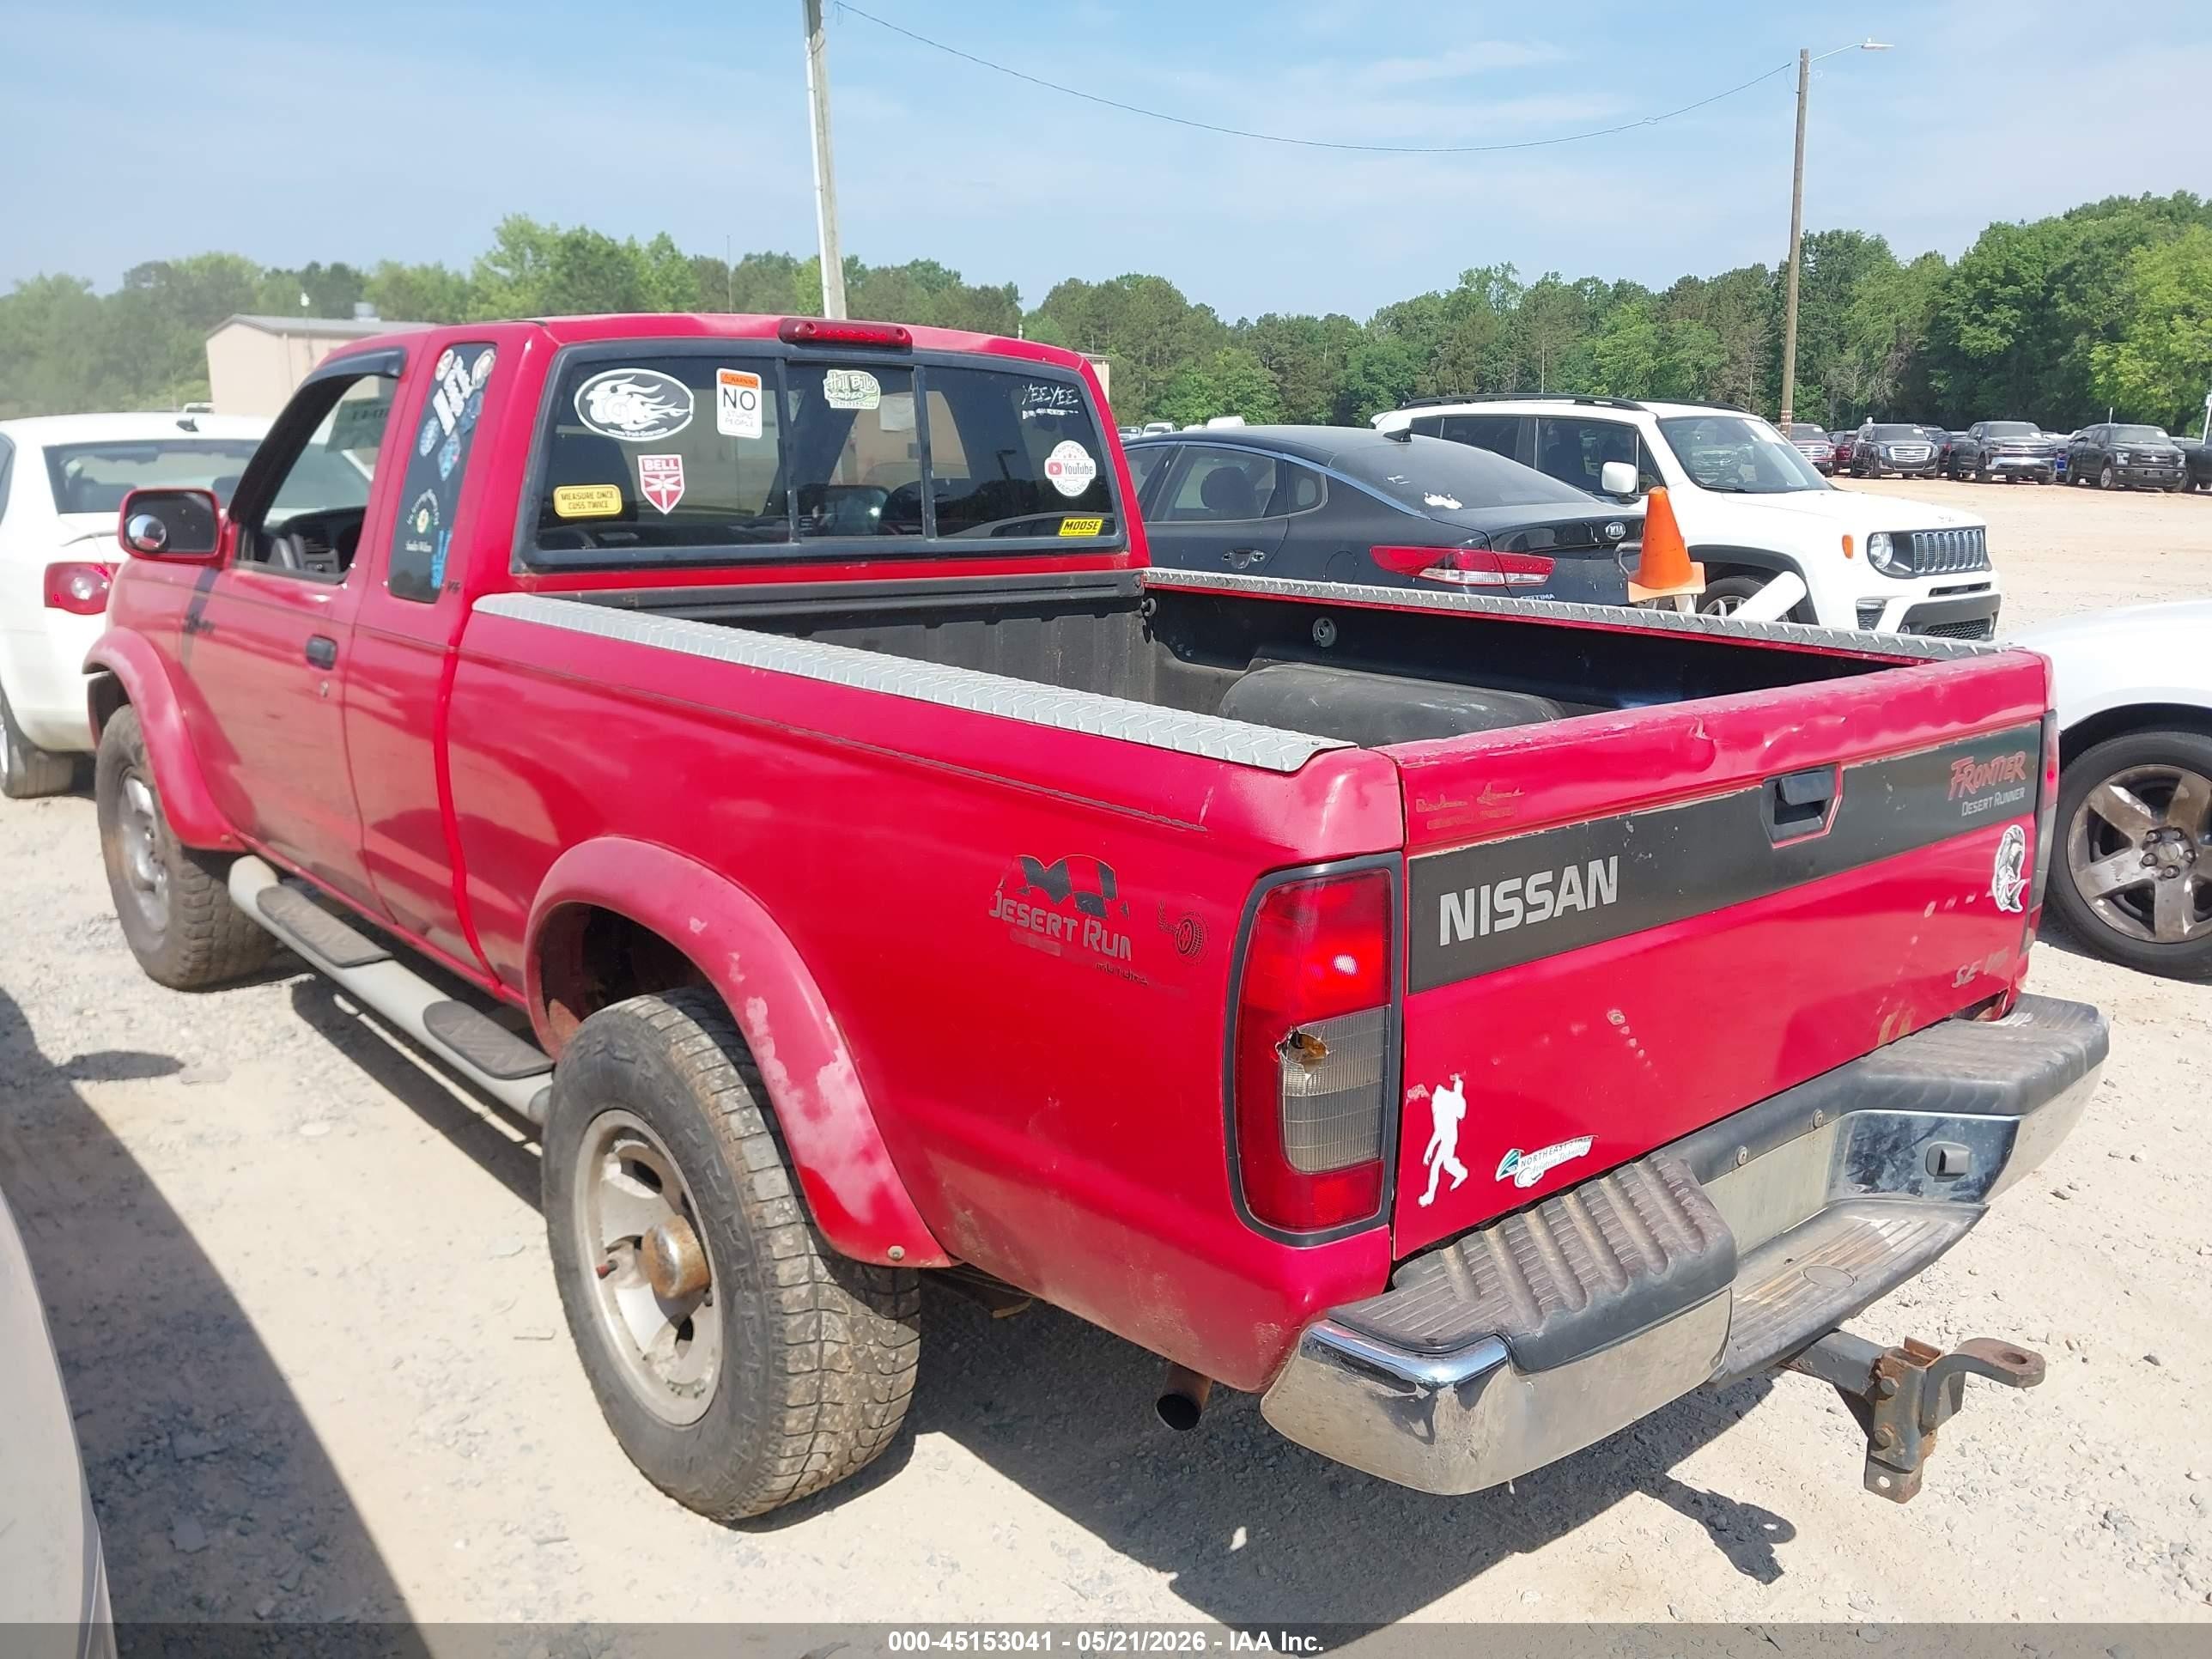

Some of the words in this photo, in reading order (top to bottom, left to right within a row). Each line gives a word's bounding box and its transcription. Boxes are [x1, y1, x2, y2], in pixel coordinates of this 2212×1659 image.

[723, 386, 756, 410] NO
[1049, 386, 1079, 407] YEE
[643, 459, 678, 471] BELL
[1064, 463, 1093, 475] YouTube
[561, 491, 594, 501] MEASURE
[1063, 520, 1100, 531] MOOSE
[1610, 525, 1624, 536] KIA
[1948, 750, 2027, 801] FRONTIER
[1961, 796, 1993, 817] DESERT
[1994, 787, 2026, 807] RUNNER
[1440, 855, 1619, 946] NISSAN
[1521, 1141, 1568, 1168] NORTHEAST
